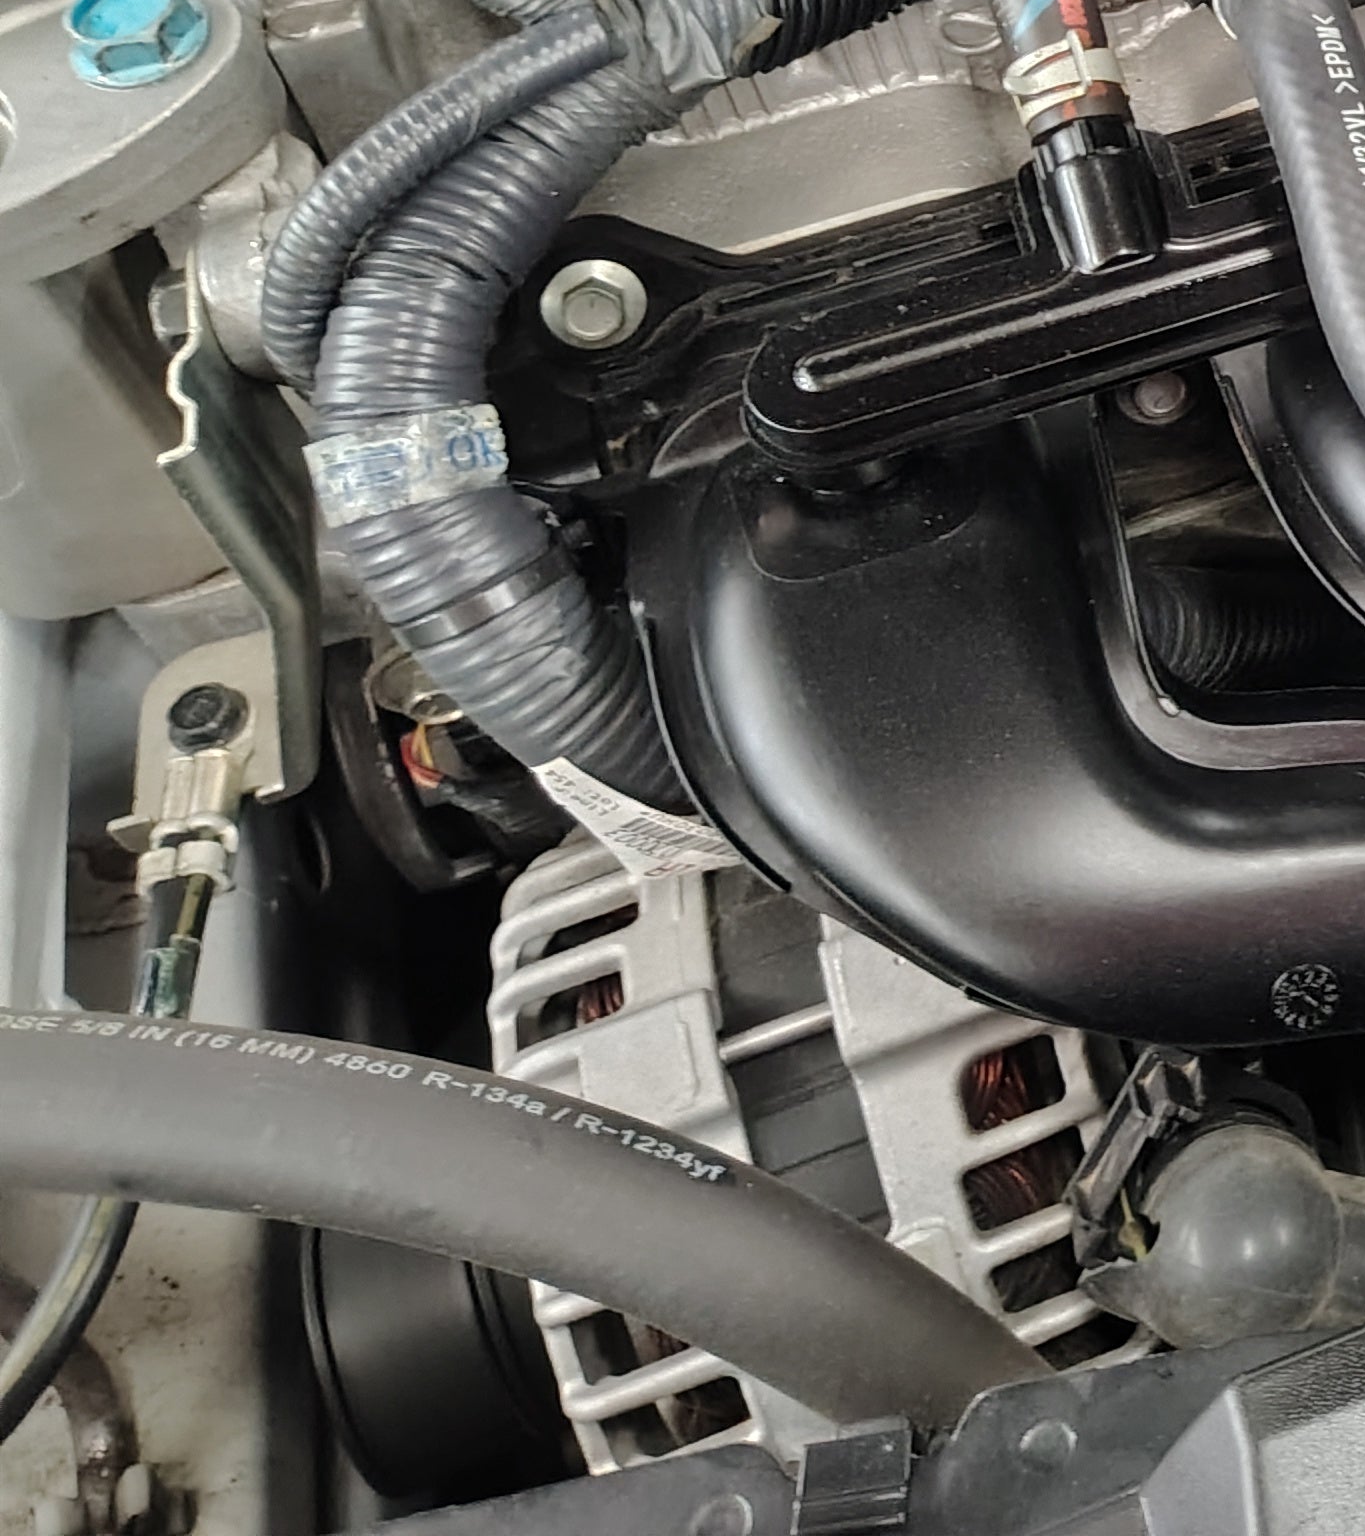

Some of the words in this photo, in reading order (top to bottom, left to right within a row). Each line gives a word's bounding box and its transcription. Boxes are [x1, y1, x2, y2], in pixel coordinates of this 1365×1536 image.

[1311, 13, 1359, 96] >EPDM<
[129, 1025, 174, 1042] IN
[174, 1030, 235, 1049] (16
[238, 1037, 316, 1065] MM)
[323, 1051, 413, 1080] 4860
[421, 1069, 546, 1117] R-134a
[573, 1112, 728, 1182] R-1234yf
